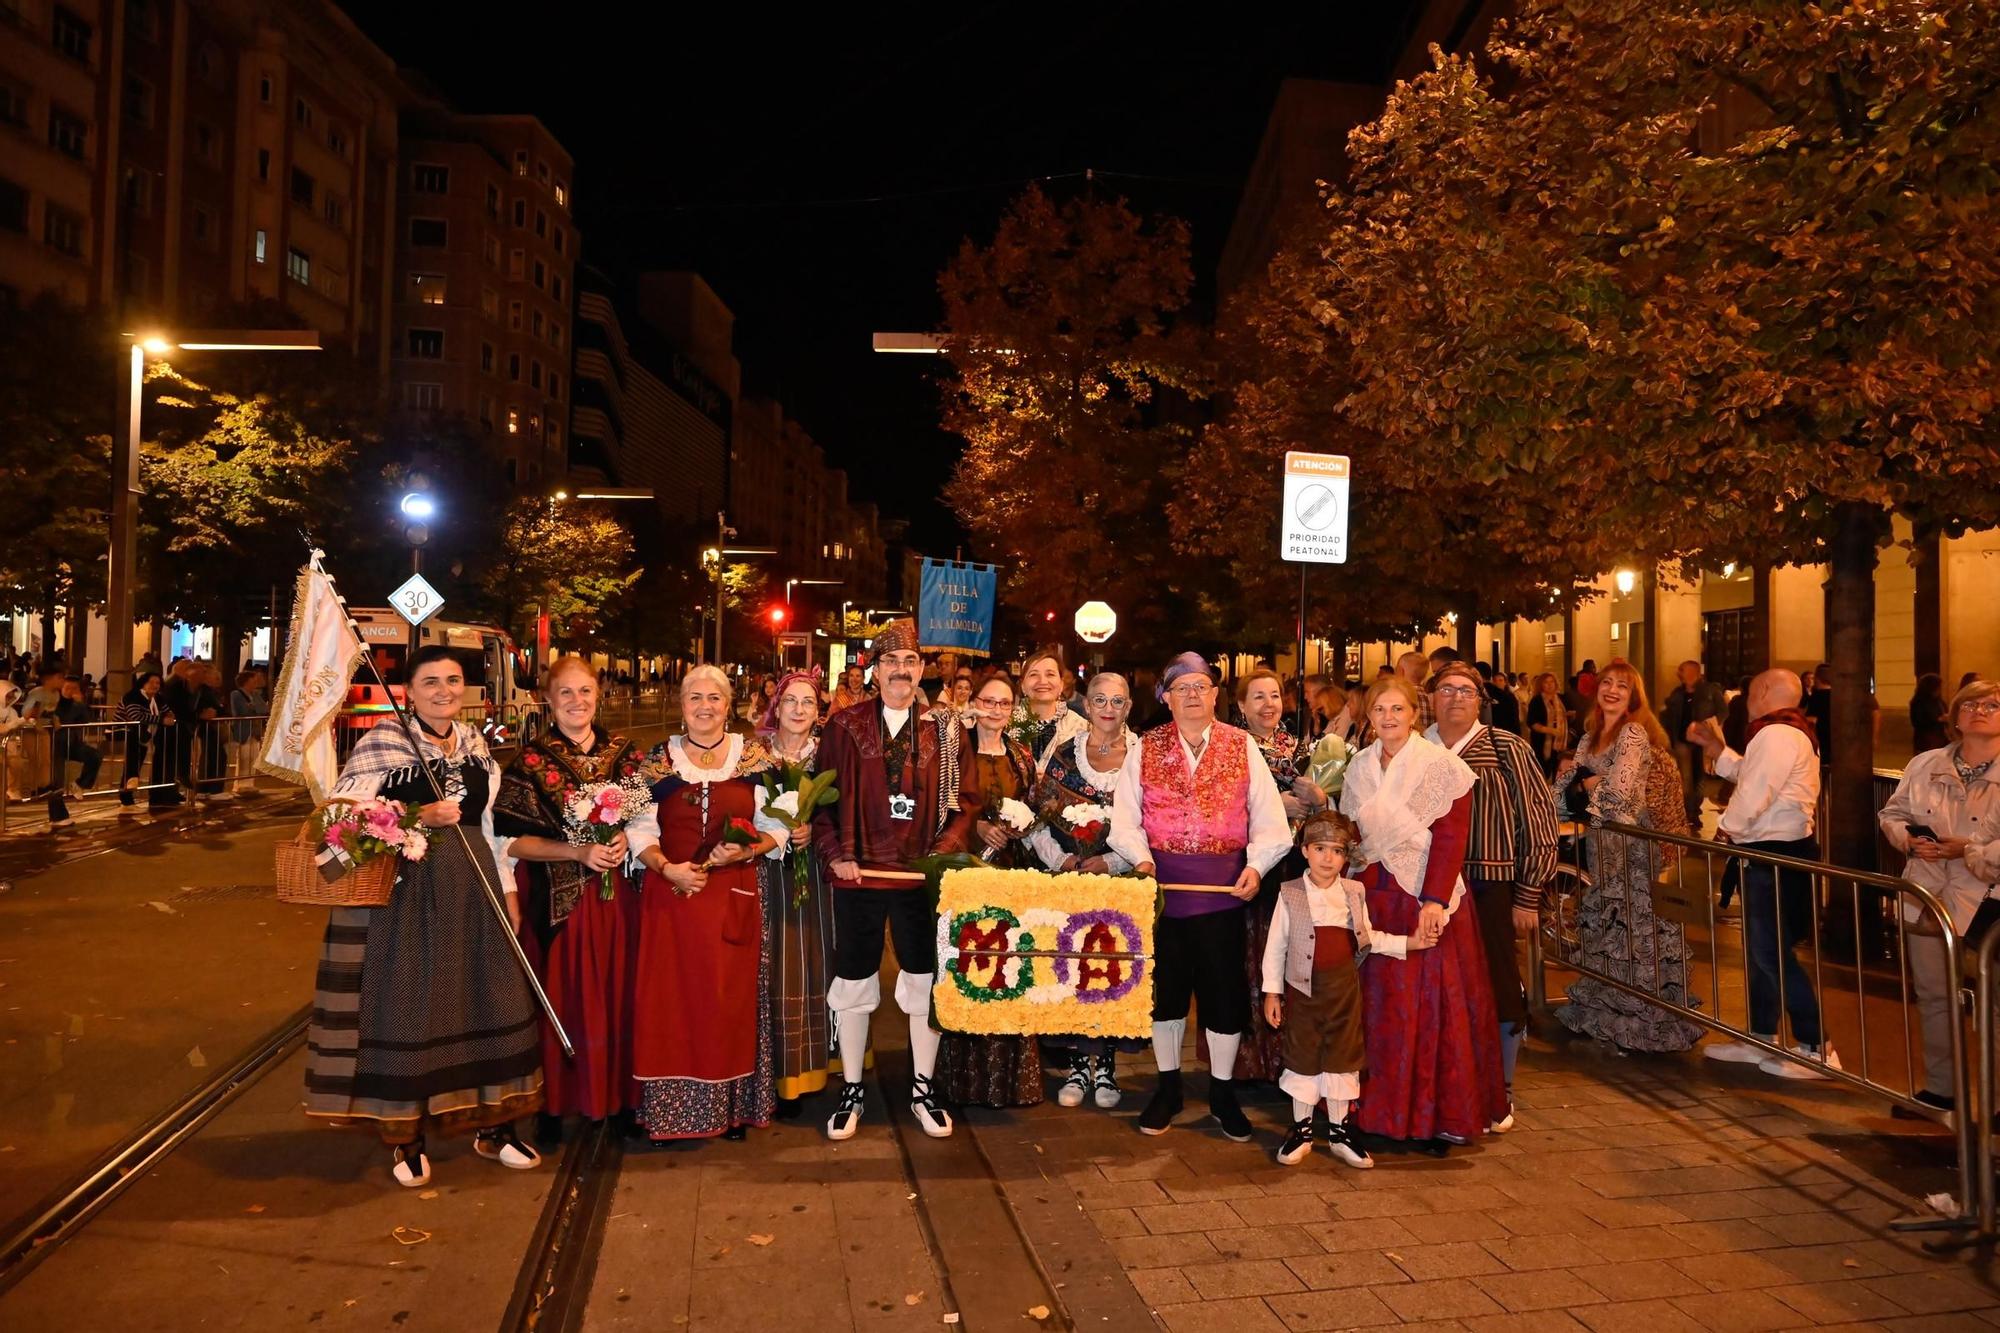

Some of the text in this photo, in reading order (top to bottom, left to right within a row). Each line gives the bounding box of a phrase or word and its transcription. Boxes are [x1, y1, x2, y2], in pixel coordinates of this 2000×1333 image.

[1289, 533, 1341, 544] PRIORIDAD
[1290, 546, 1339, 556] PEATONAL
[938, 584, 978, 598] VILLA
[404, 590, 428, 608] 30
[951, 601, 967, 613] DE
[930, 618, 983, 633] LA ALMOLDA
